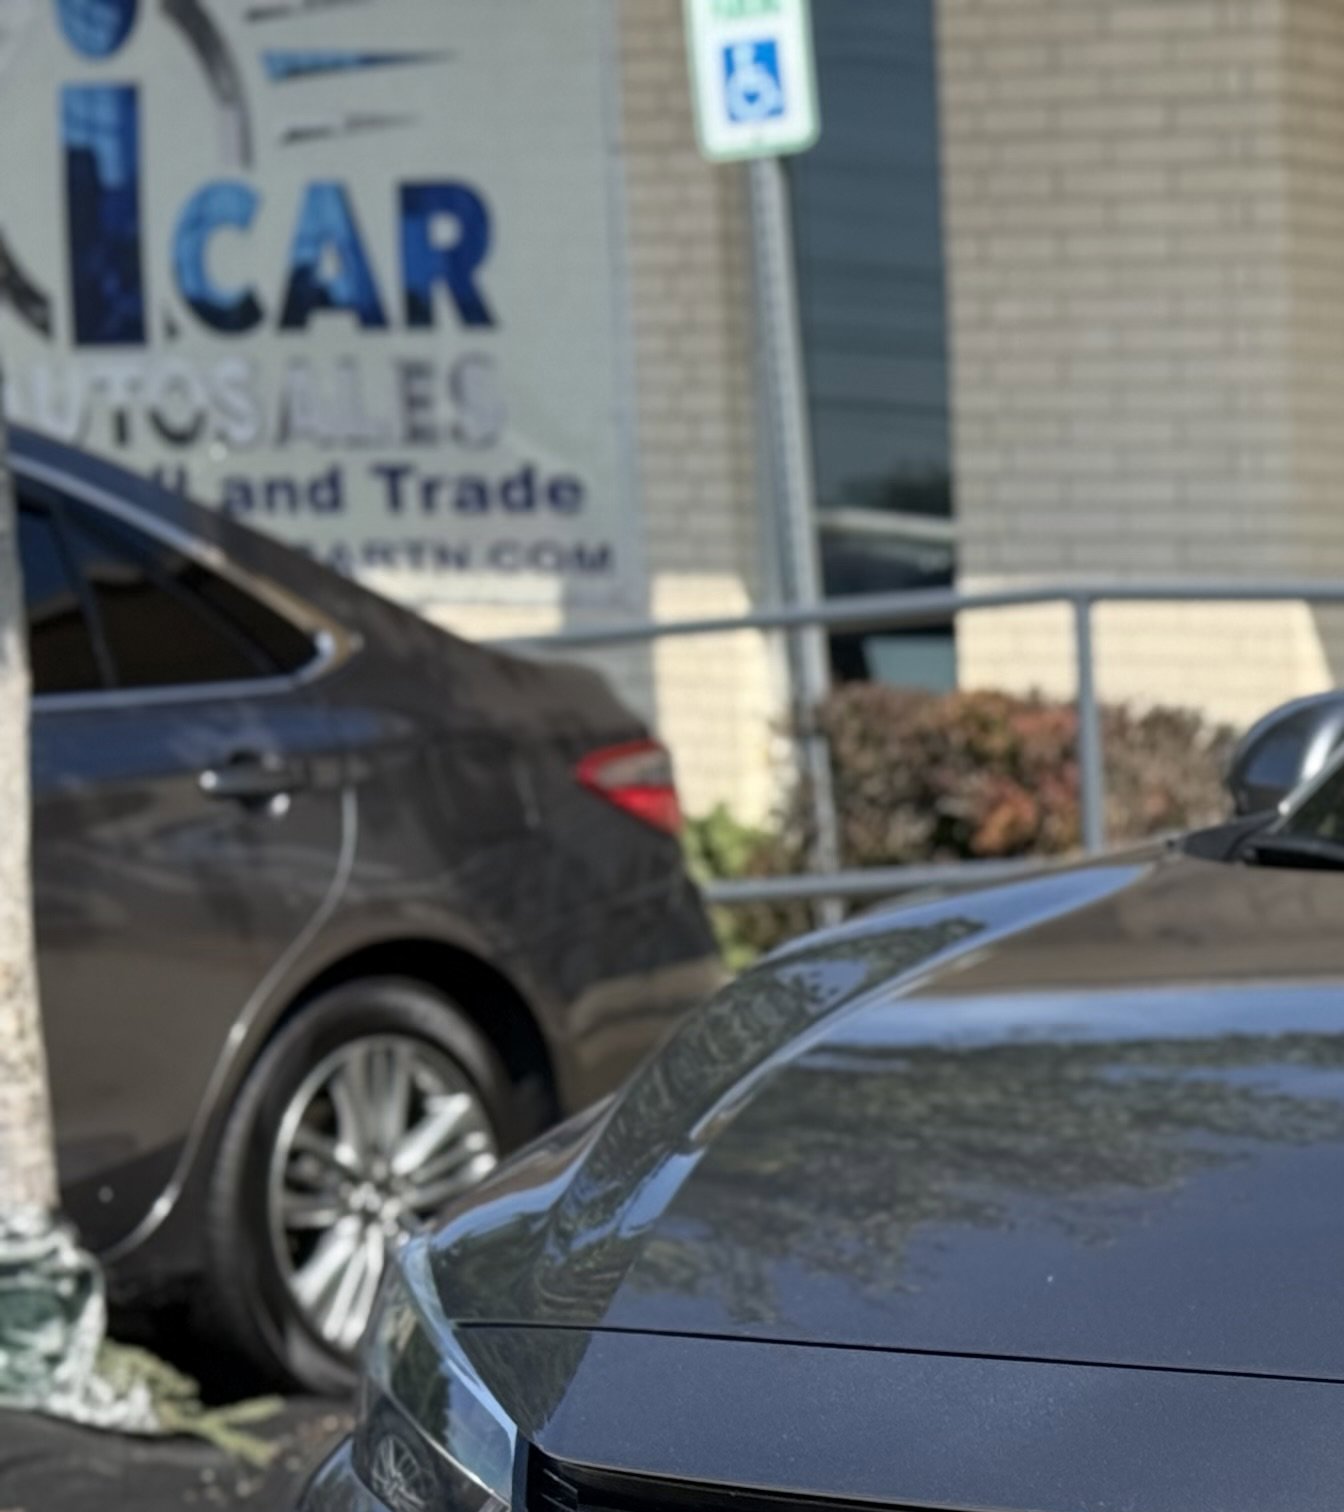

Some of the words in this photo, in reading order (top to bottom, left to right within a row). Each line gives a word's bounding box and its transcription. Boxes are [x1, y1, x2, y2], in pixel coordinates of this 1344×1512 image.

[0, 352, 508, 451] UTOSALES
[222, 462, 346, 513] and
[370, 462, 586, 517] Trade
